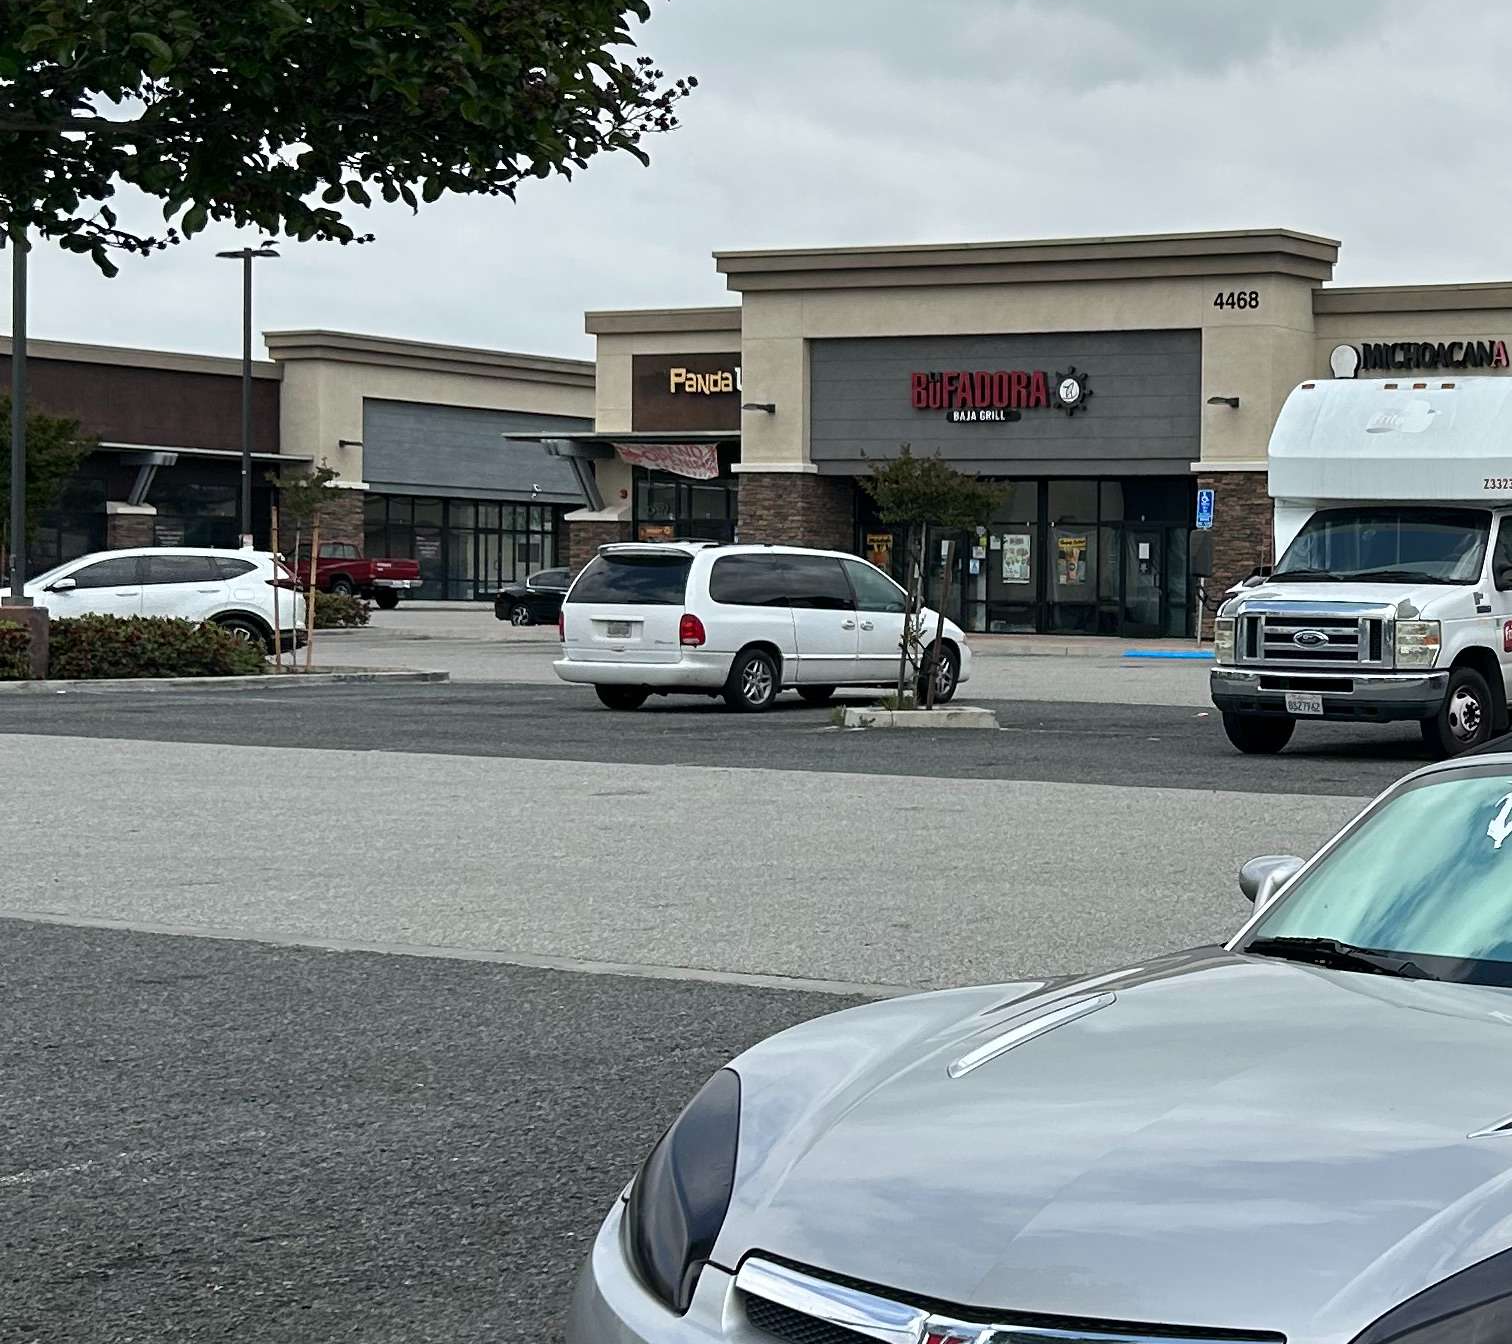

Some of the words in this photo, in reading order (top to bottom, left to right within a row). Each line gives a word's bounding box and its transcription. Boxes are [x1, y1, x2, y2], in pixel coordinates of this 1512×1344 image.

[1213, 290, 1259, 310] 4468
[1360, 340, 1510, 370] MICHOACANA
[670, 367, 733, 395] Panda
[953, 409, 977, 421] BAJA
[979, 409, 1006, 421] GRILL
